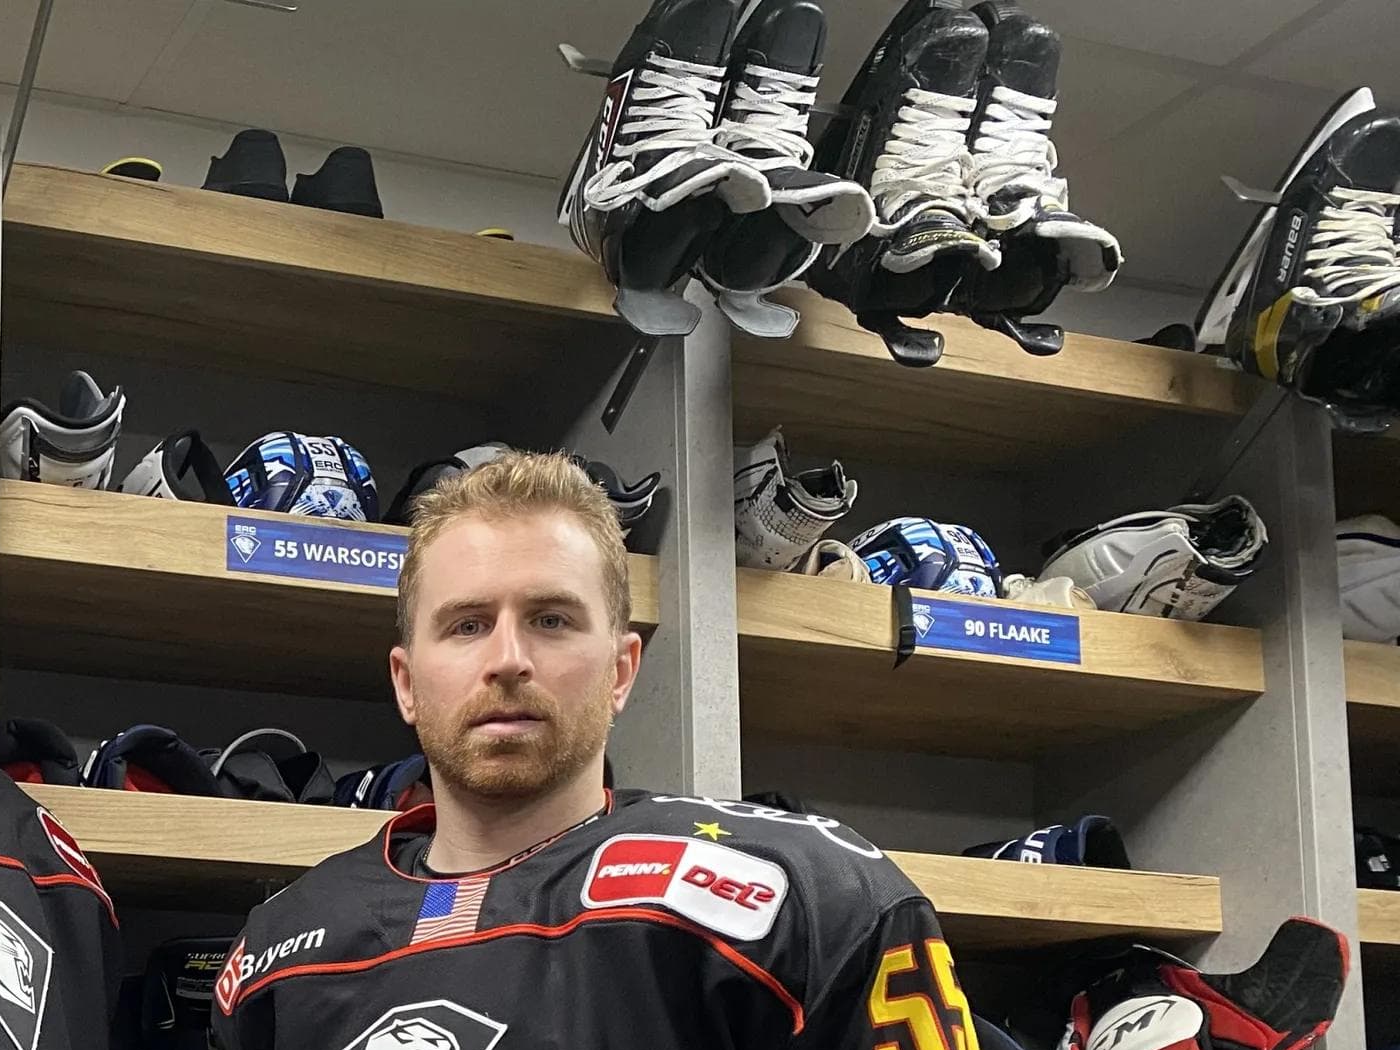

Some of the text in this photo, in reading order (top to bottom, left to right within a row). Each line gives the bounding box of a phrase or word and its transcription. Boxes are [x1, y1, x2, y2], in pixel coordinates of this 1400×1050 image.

[310, 442, 335, 457] 55
[315, 460, 344, 471] ERC
[274, 539, 298, 559] 55
[964, 619, 1050, 645] 90 FLAAKE
